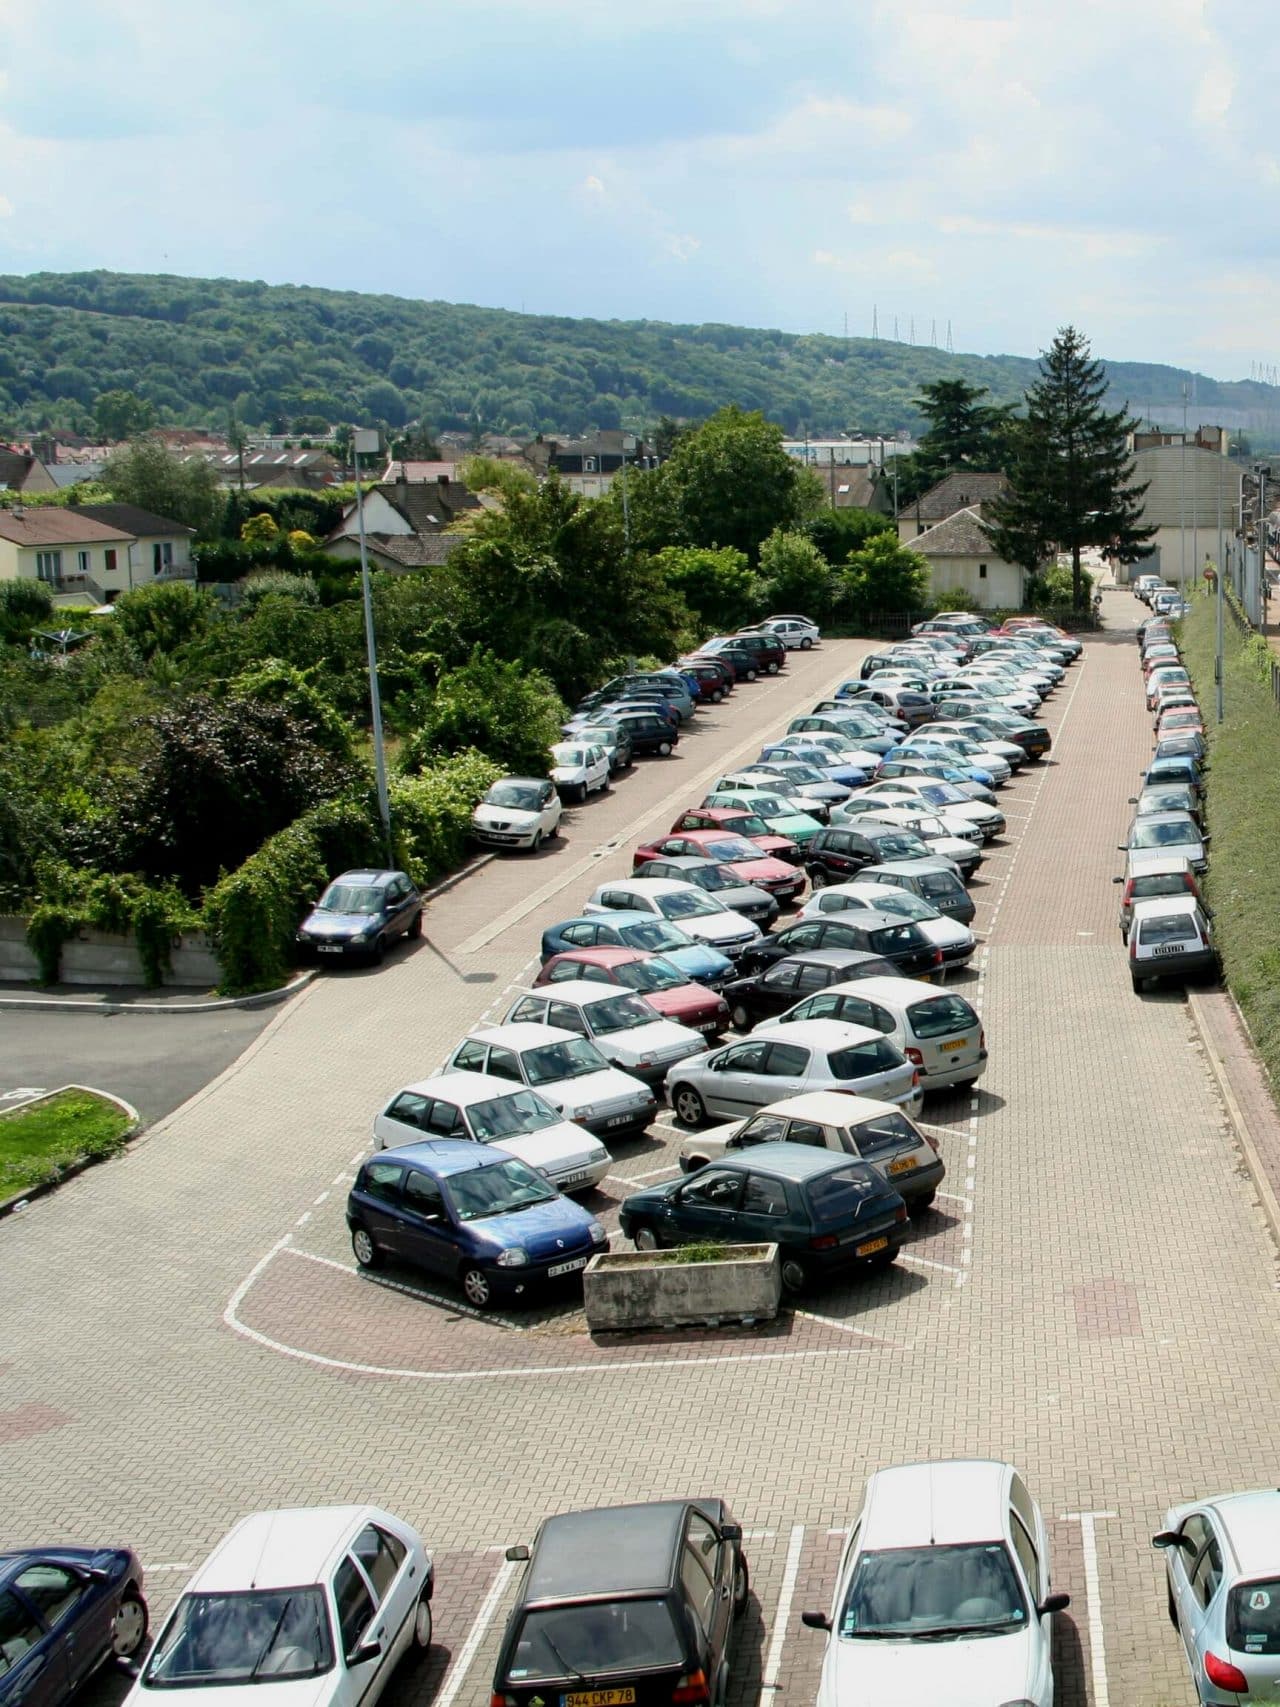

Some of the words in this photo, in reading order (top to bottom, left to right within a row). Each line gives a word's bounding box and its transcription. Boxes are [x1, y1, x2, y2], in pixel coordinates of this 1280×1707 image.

[1254, 1593, 1265, 1606] A
[567, 1695, 589, 1707] 944
[592, 1690, 614, 1705] CKP
[619, 1688, 633, 1703] 78
